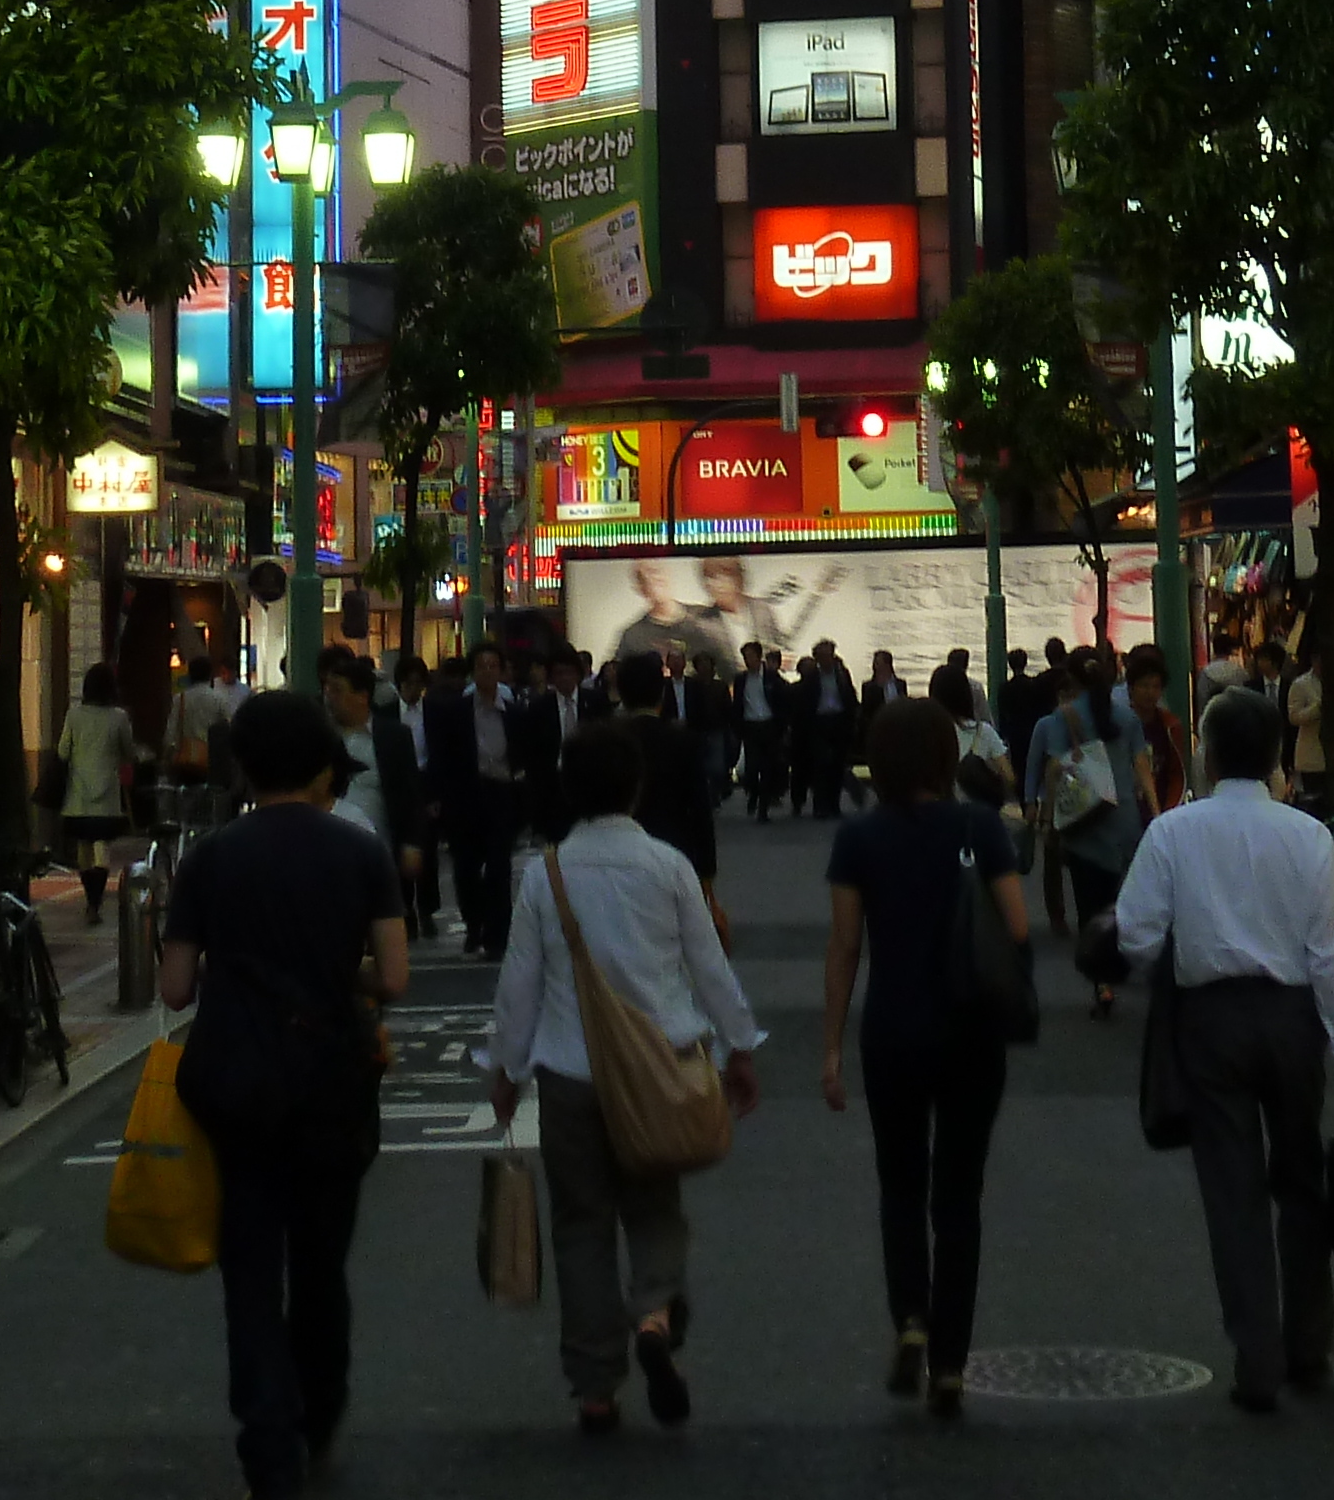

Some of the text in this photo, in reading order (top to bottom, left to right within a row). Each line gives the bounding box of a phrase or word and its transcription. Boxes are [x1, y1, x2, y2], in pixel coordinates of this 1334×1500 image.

[806, 32, 845, 51] iPad
[515, 127, 635, 174] ビックポイントが
[527, 163, 616, 201] icaになる!
[772, 240, 892, 288] ビック
[560, 434, 588, 447] HONEY
[592, 446, 605, 476] 3
[698, 457, 788, 479] BRAVIA
[72, 471, 152, 494] 中村屋
